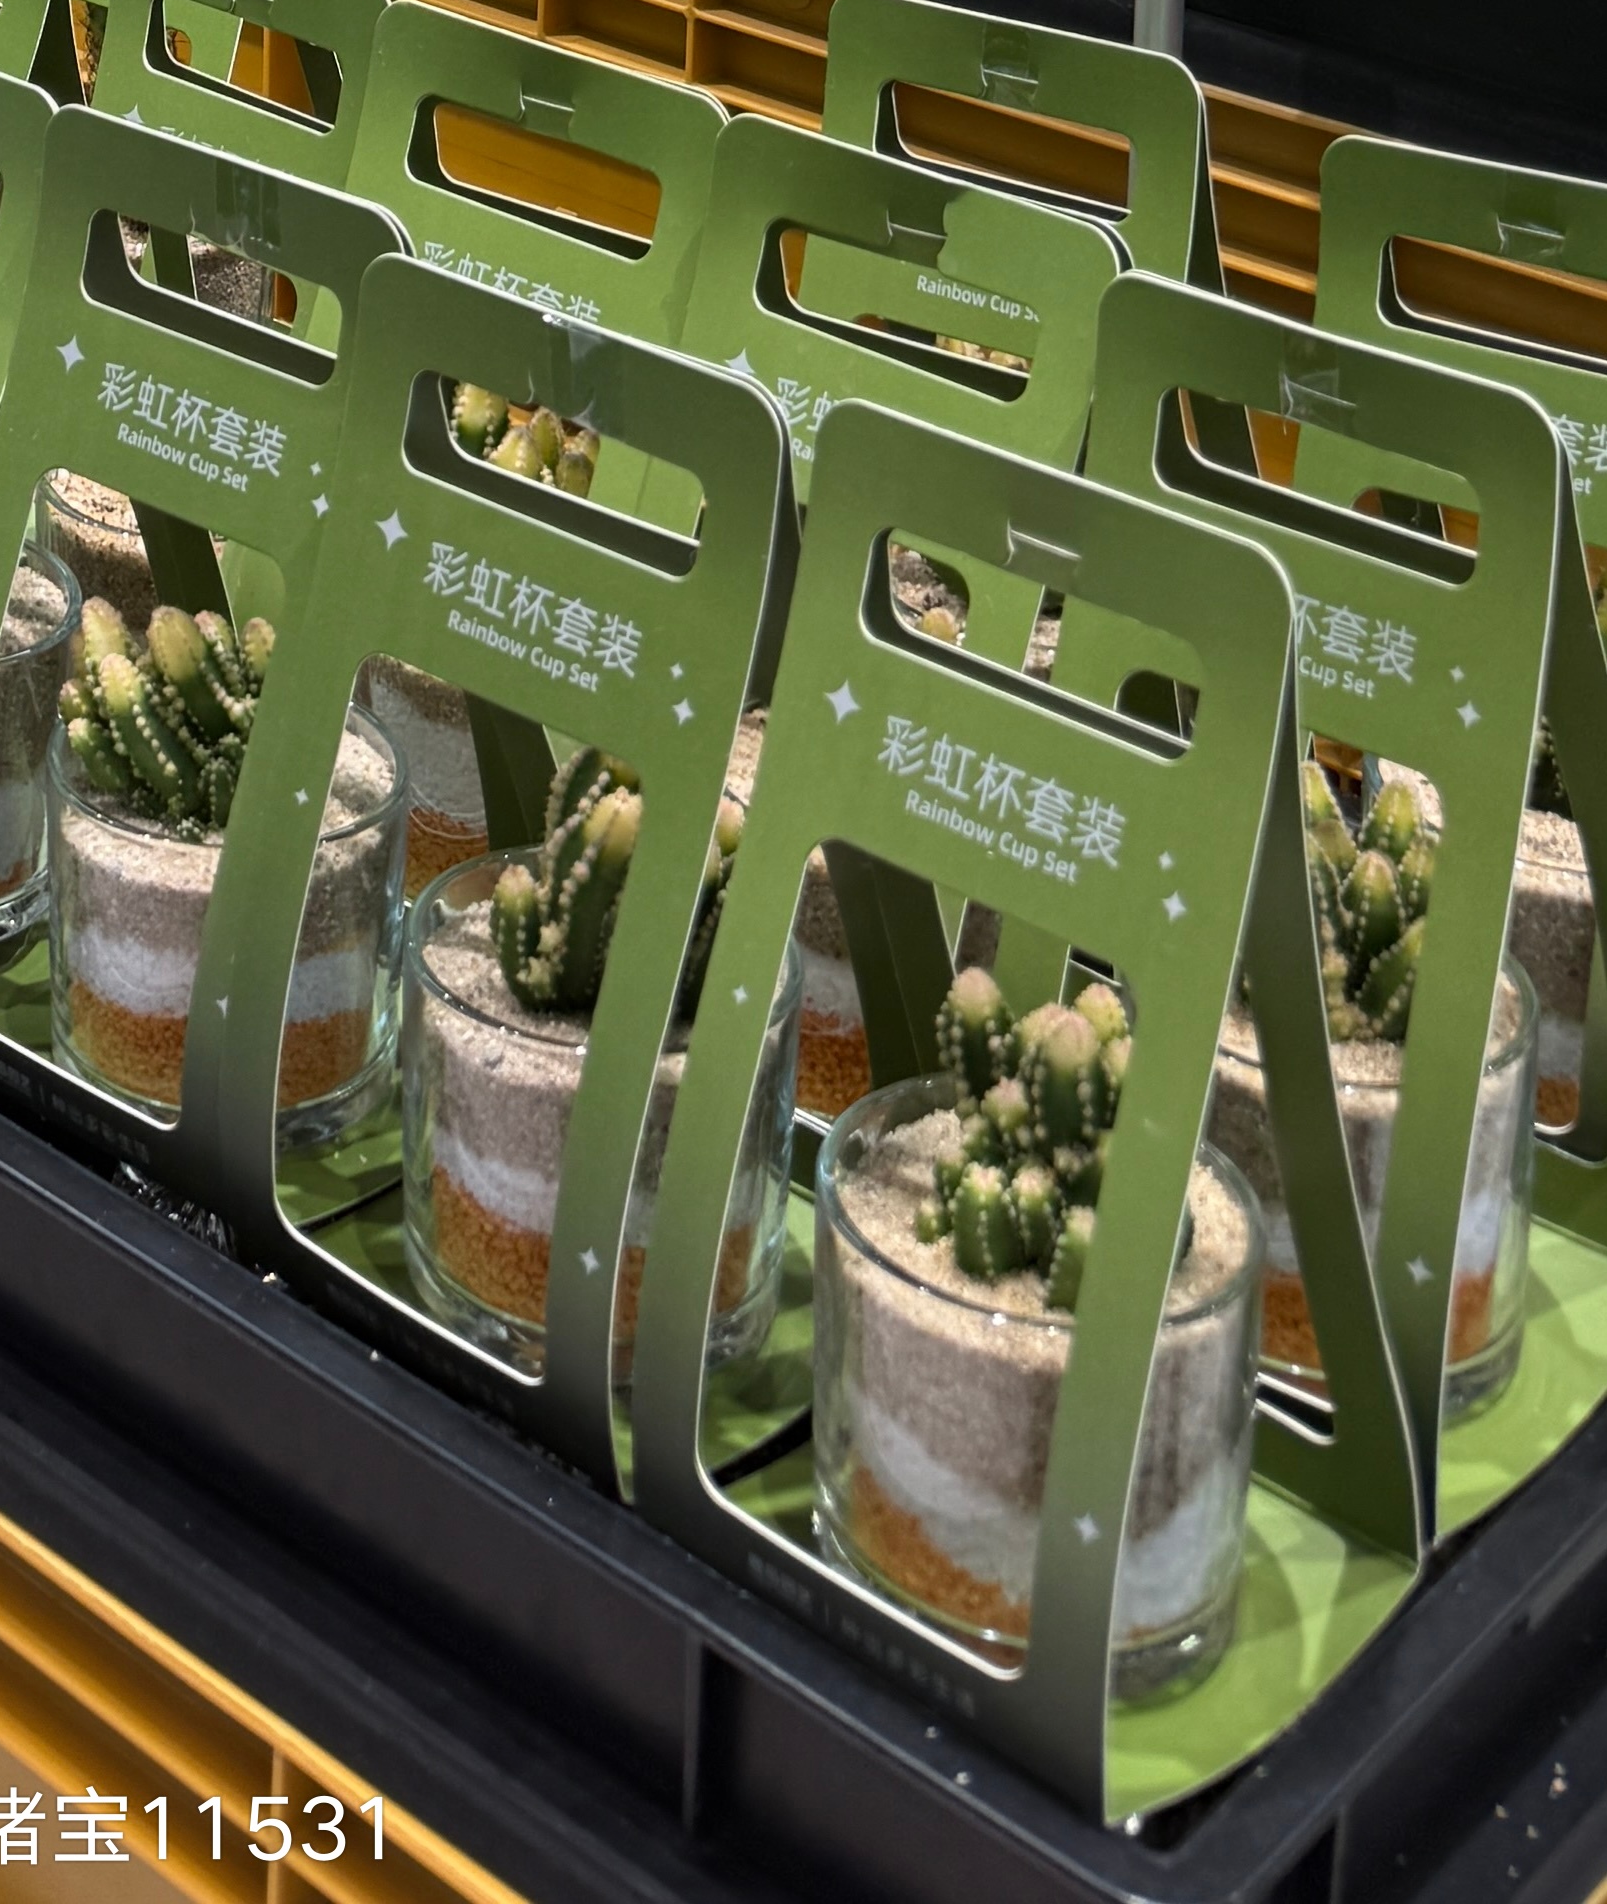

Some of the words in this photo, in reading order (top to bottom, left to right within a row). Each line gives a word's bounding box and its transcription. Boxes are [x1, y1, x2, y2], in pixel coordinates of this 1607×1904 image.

[917, 273, 987, 309] Rainbow
[989, 294, 1020, 323] Cup
[97, 363, 287, 477] 彩虹杯套装
[118, 423, 187, 467] Rainbow
[189, 450, 220, 483] Cup
[222, 464, 248, 492] Set
[424, 541, 643, 679] 彩虹杯套装
[447, 608, 527, 663] Rainbow
[529, 645, 566, 682] Cup
[567, 661, 600, 694] Set
[1299, 655, 1337, 695] Cup
[1338, 667, 1376, 699] Set
[877, 716, 1128, 870] 彩虹杯套装
[905, 789, 995, 848] Rainbow
[997, 832, 1040, 874] Cup
[1041, 849, 1080, 885] Set
